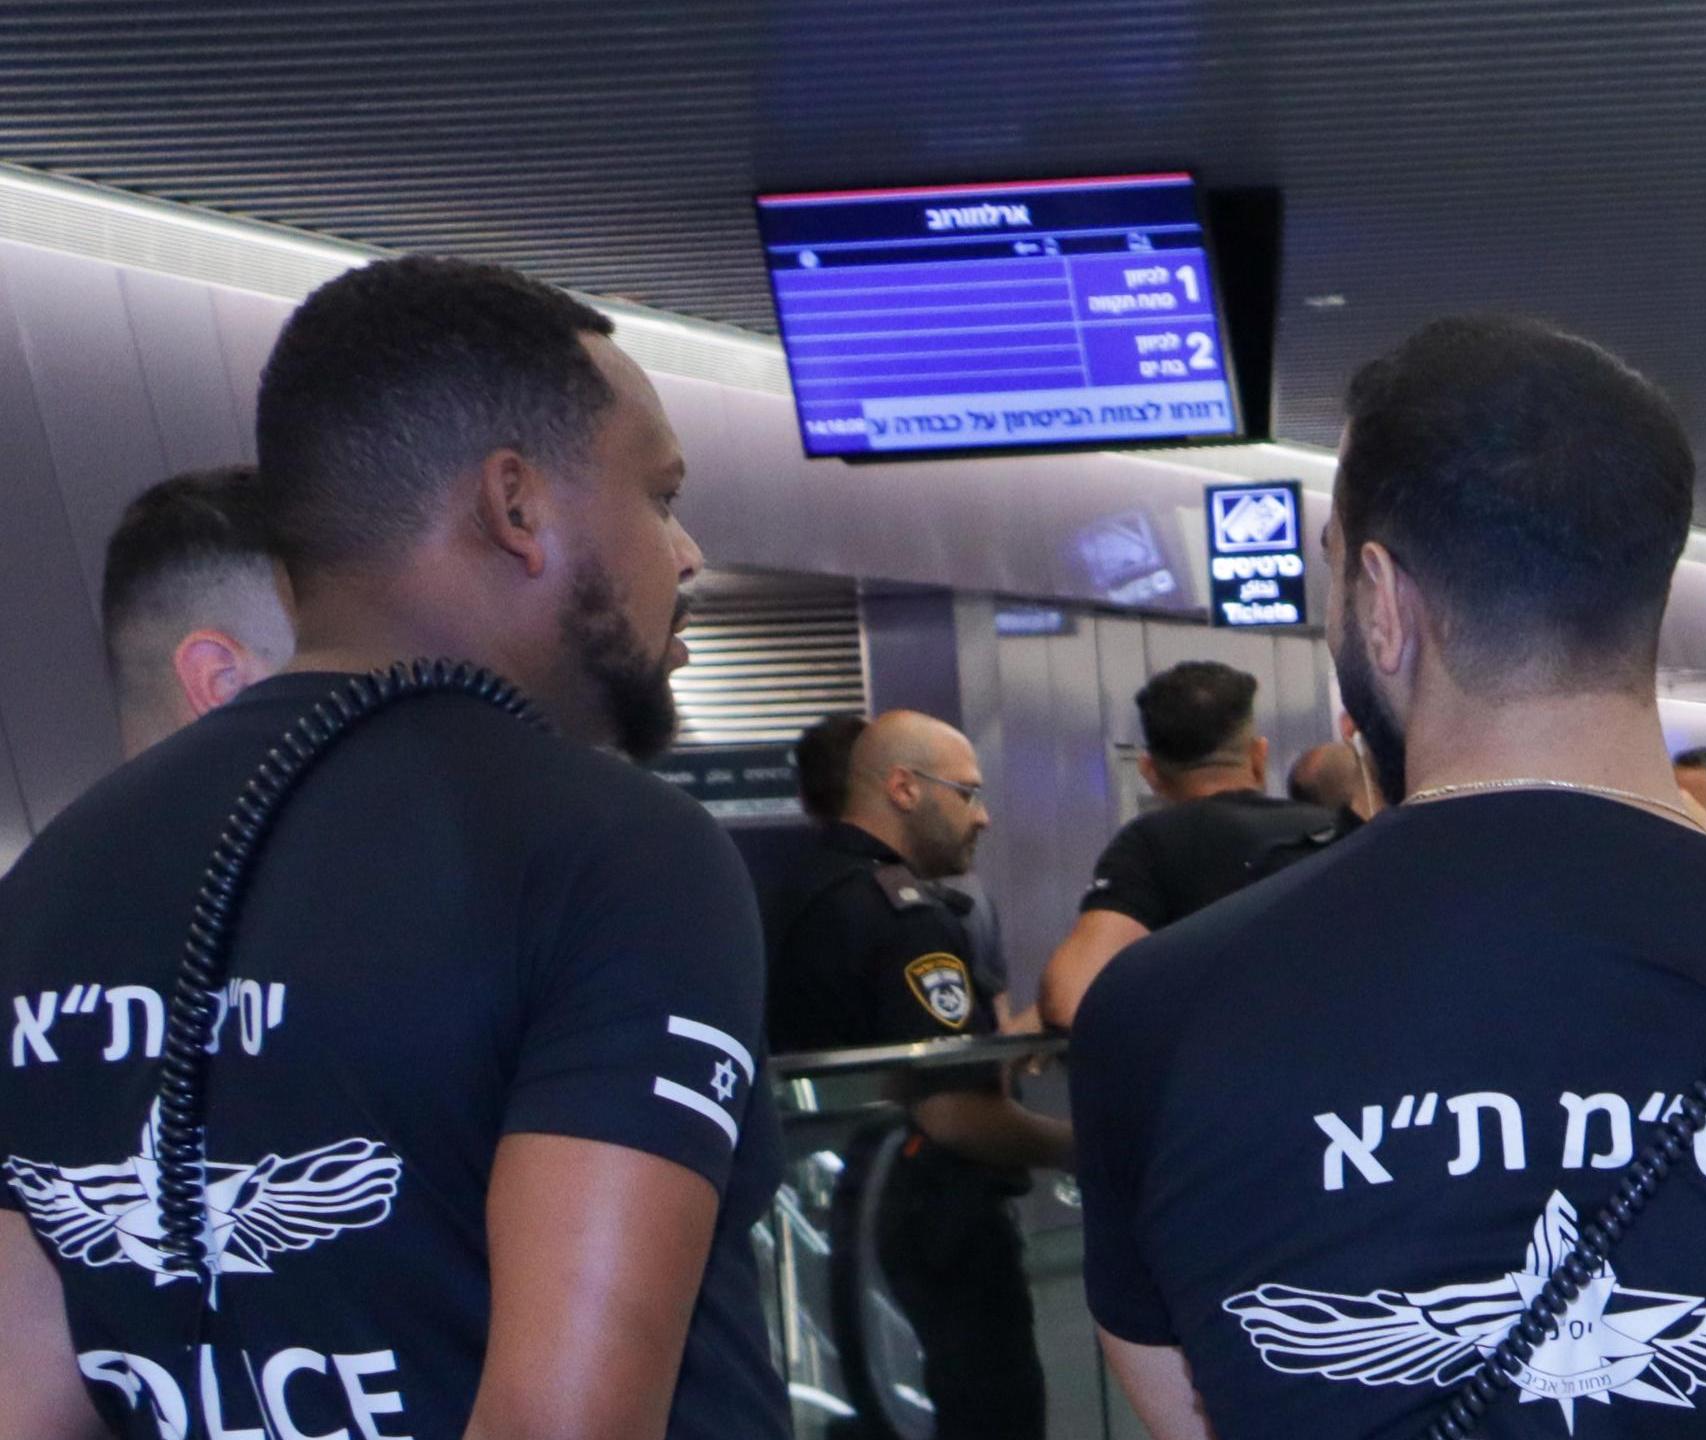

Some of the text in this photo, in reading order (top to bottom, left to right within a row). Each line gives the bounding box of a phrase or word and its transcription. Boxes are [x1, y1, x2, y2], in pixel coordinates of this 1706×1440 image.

[1176, 265, 1200, 302] 1
[1185, 331, 1218, 370] 2
[967, 409, 997, 430] על
[1003, 406, 1094, 433] הביטחון
[1222, 602, 1299, 625] Tickets
[12, 983, 165, 1068] ת"א
[1313, 1090, 1527, 1191] ת"א
[1520, 1371, 1558, 1393] אביב
[1579, 1373, 1613, 1392] מחוז
